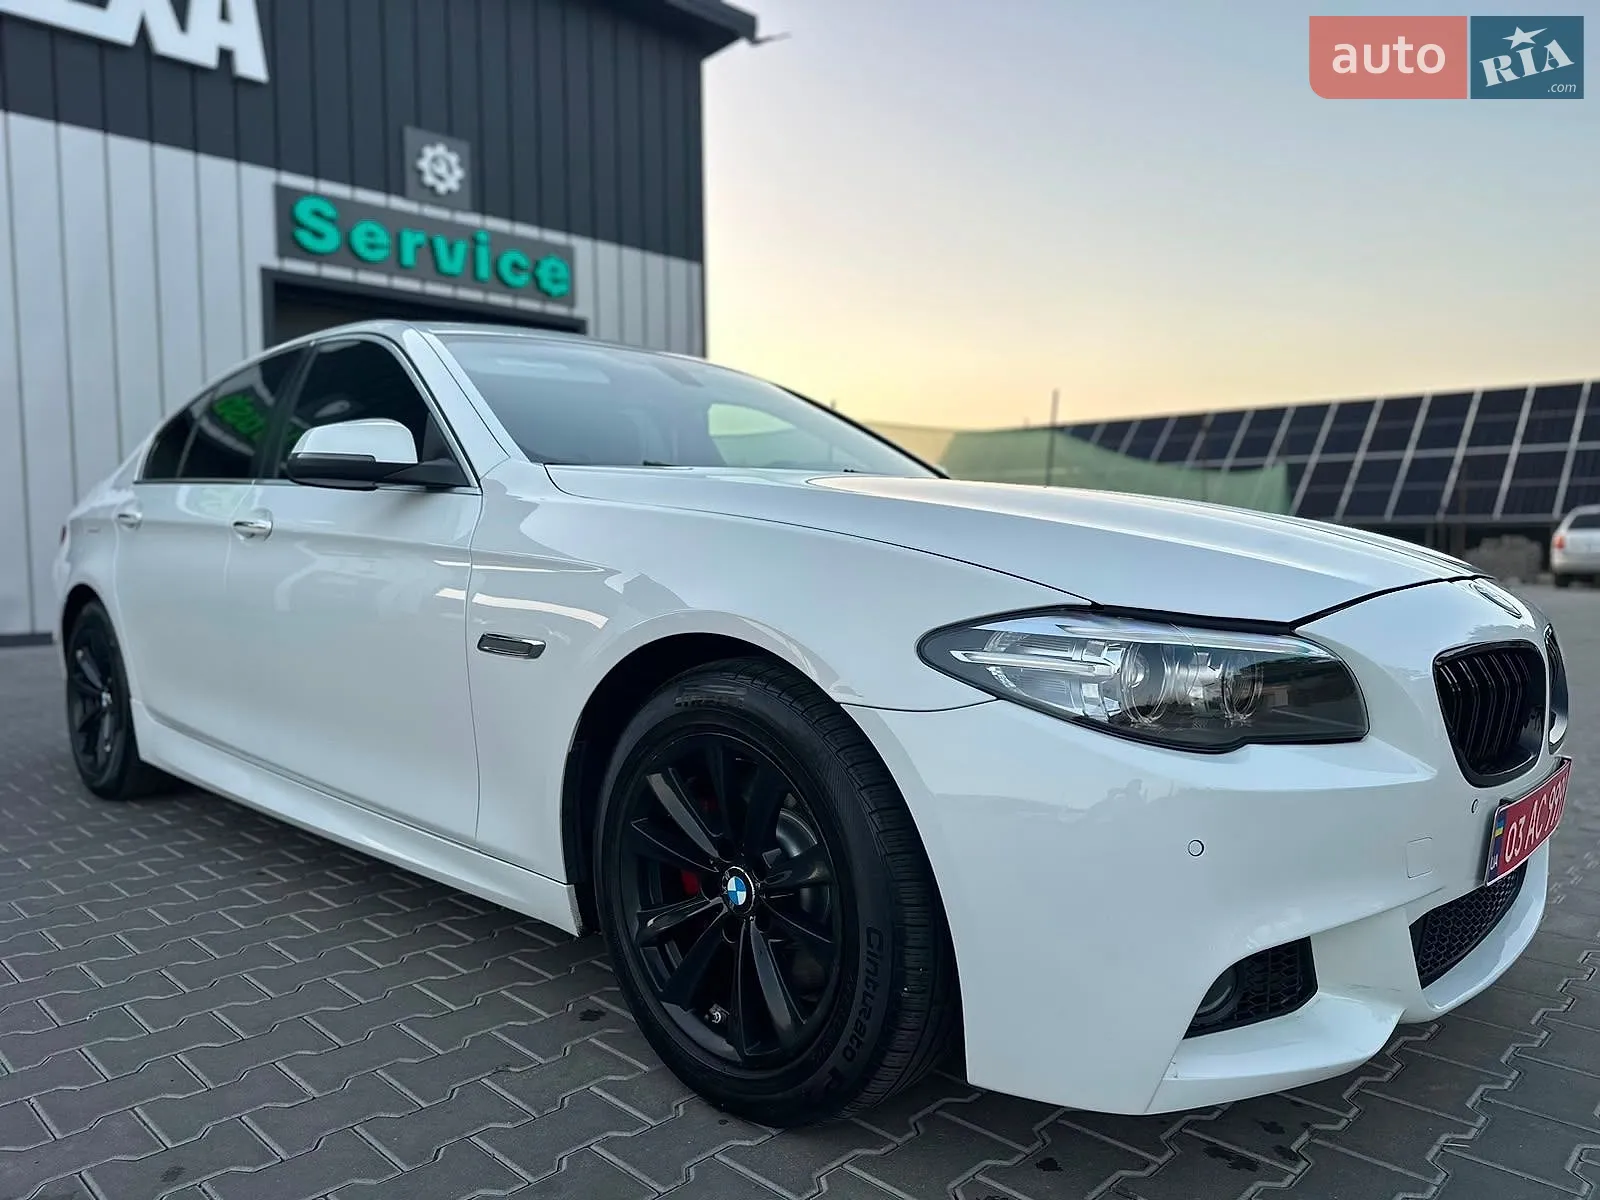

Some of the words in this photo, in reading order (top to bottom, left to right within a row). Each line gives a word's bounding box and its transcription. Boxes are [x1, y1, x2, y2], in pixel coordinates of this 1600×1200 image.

[293, 195, 571, 298] Service
[1505, 815, 1527, 863] 03
[1524, 794, 1546, 850] AC
